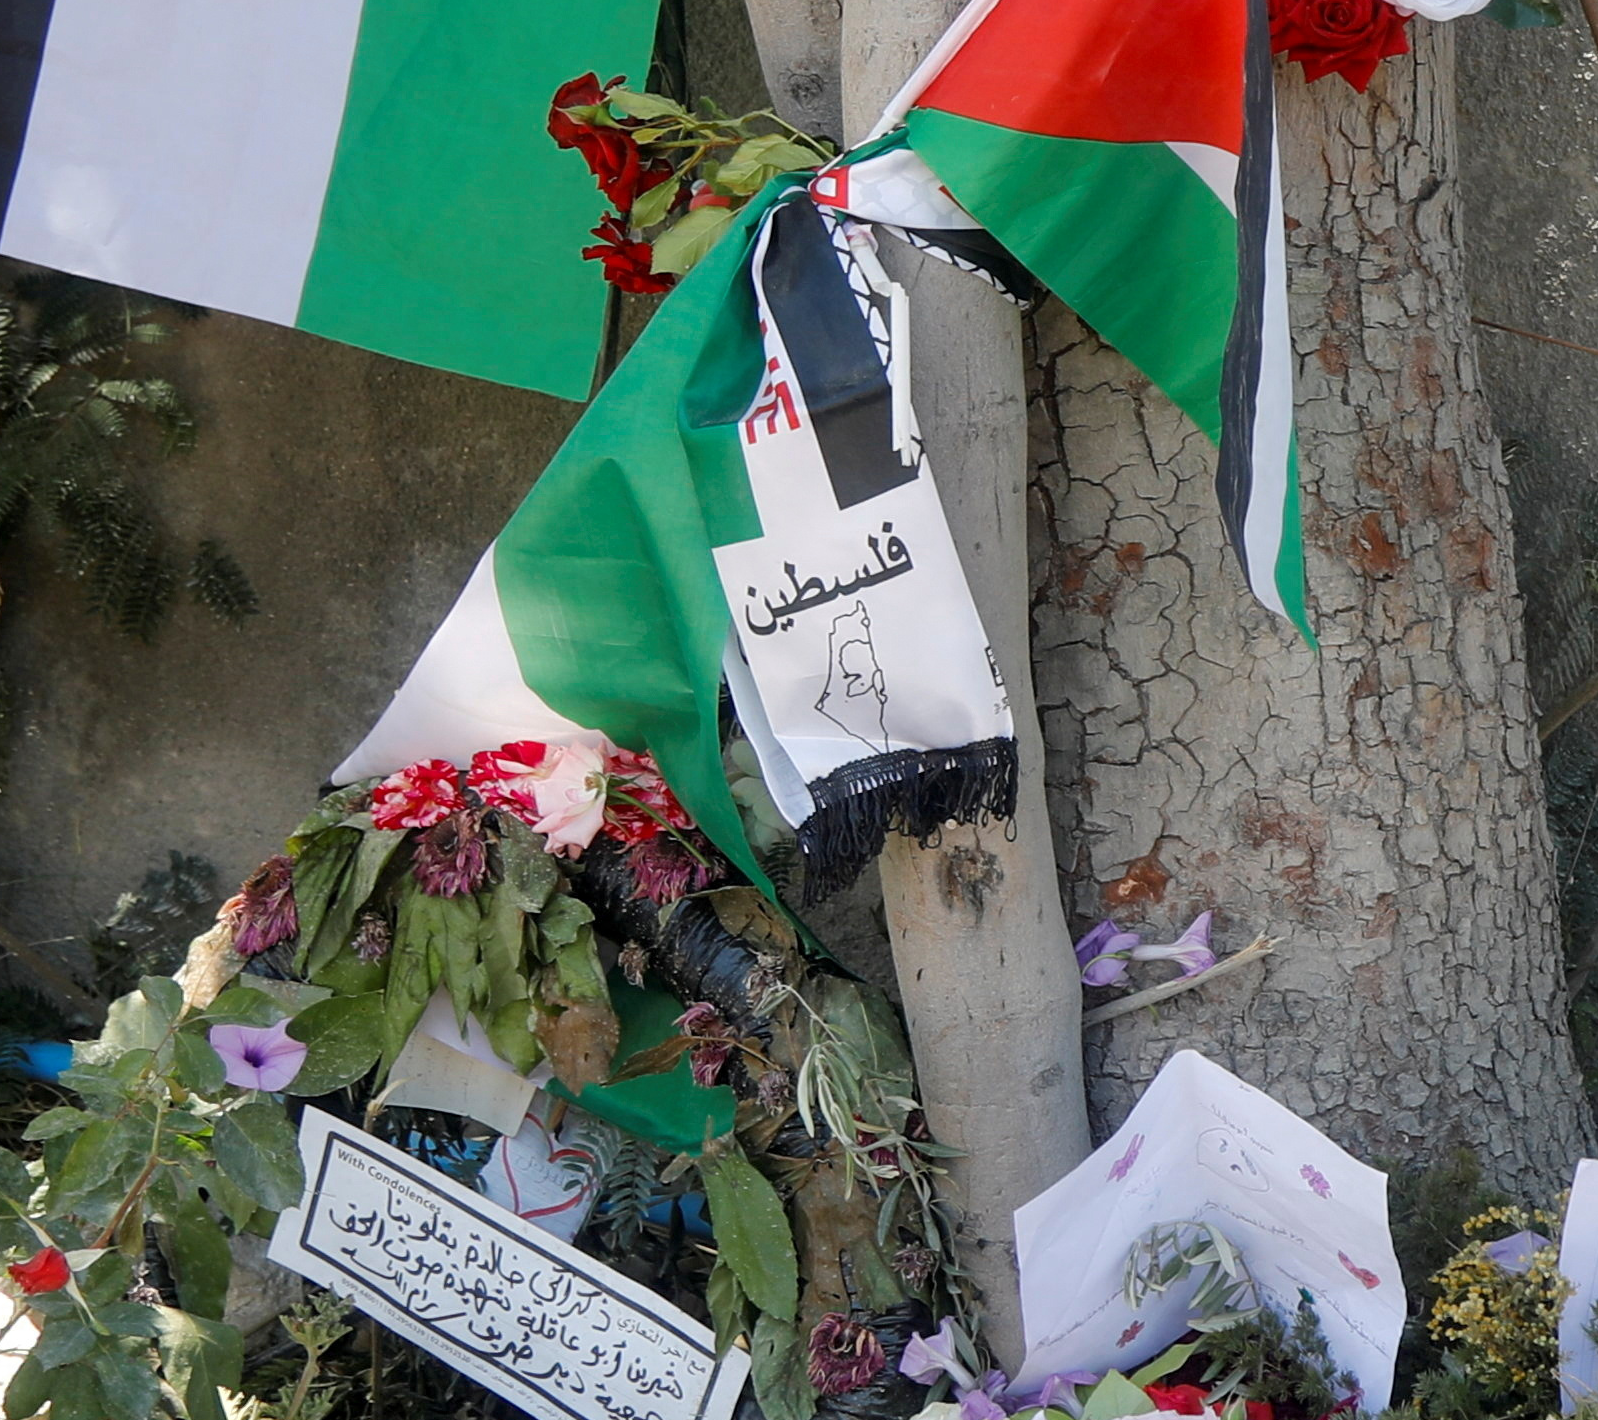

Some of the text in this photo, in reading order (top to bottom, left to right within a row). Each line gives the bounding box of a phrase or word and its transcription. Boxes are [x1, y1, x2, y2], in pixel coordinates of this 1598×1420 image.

[744, 520, 914, 636] فلسطين
[338, 1149, 440, 1216] With Condolences
[516, 1305, 579, 1350] عاقلة
[581, 1326, 626, 1377] أبو
[626, 1356, 695, 1400] شيرين
